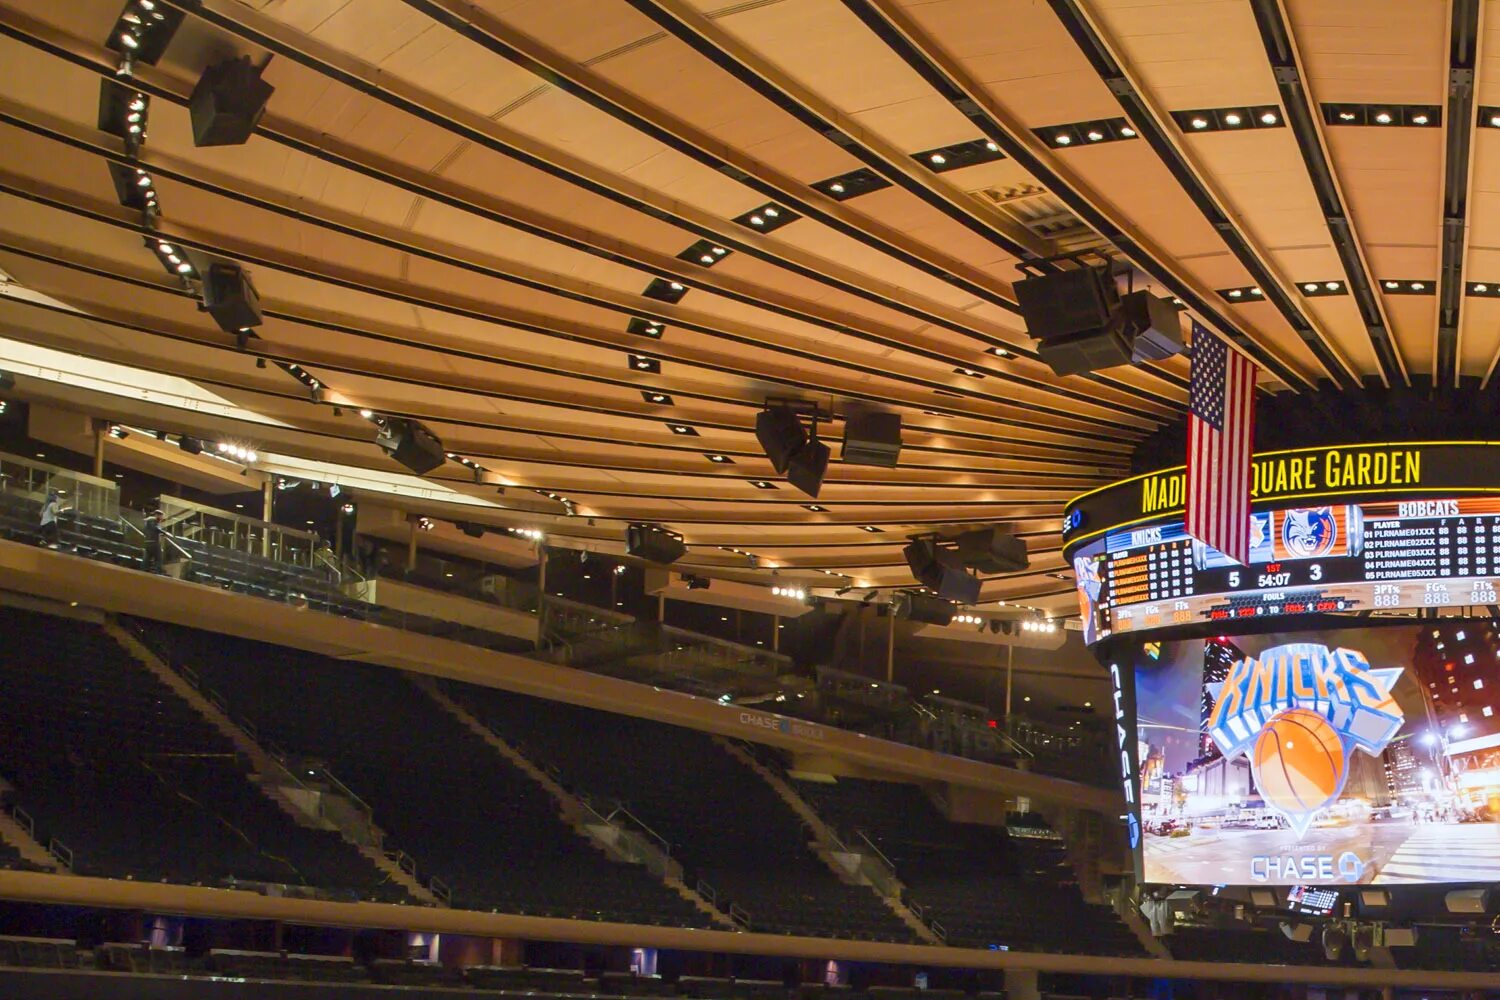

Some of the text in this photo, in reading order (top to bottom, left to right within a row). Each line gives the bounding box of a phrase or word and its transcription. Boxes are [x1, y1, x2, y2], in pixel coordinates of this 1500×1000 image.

[1142, 451, 1421, 512] MADI QUARE GARDEN
[1399, 501, 1459, 517] BOBCATS
[1374, 521, 1400, 529] PLAYER
[1132, 528, 1161, 545] KNICKS
[1229, 564, 1322, 587] 5 54:07 3
[1374, 581, 1493, 594] 3PT% FG% FT%
[1263, 592, 1284, 601] FOULS
[1375, 591, 1496, 606] 888 888 888
[1175, 602, 1189, 610] FT%
[1208, 647, 1404, 729] KNICKS
[740, 713, 779, 730] CHASE
[1250, 855, 1334, 882] CHASE
